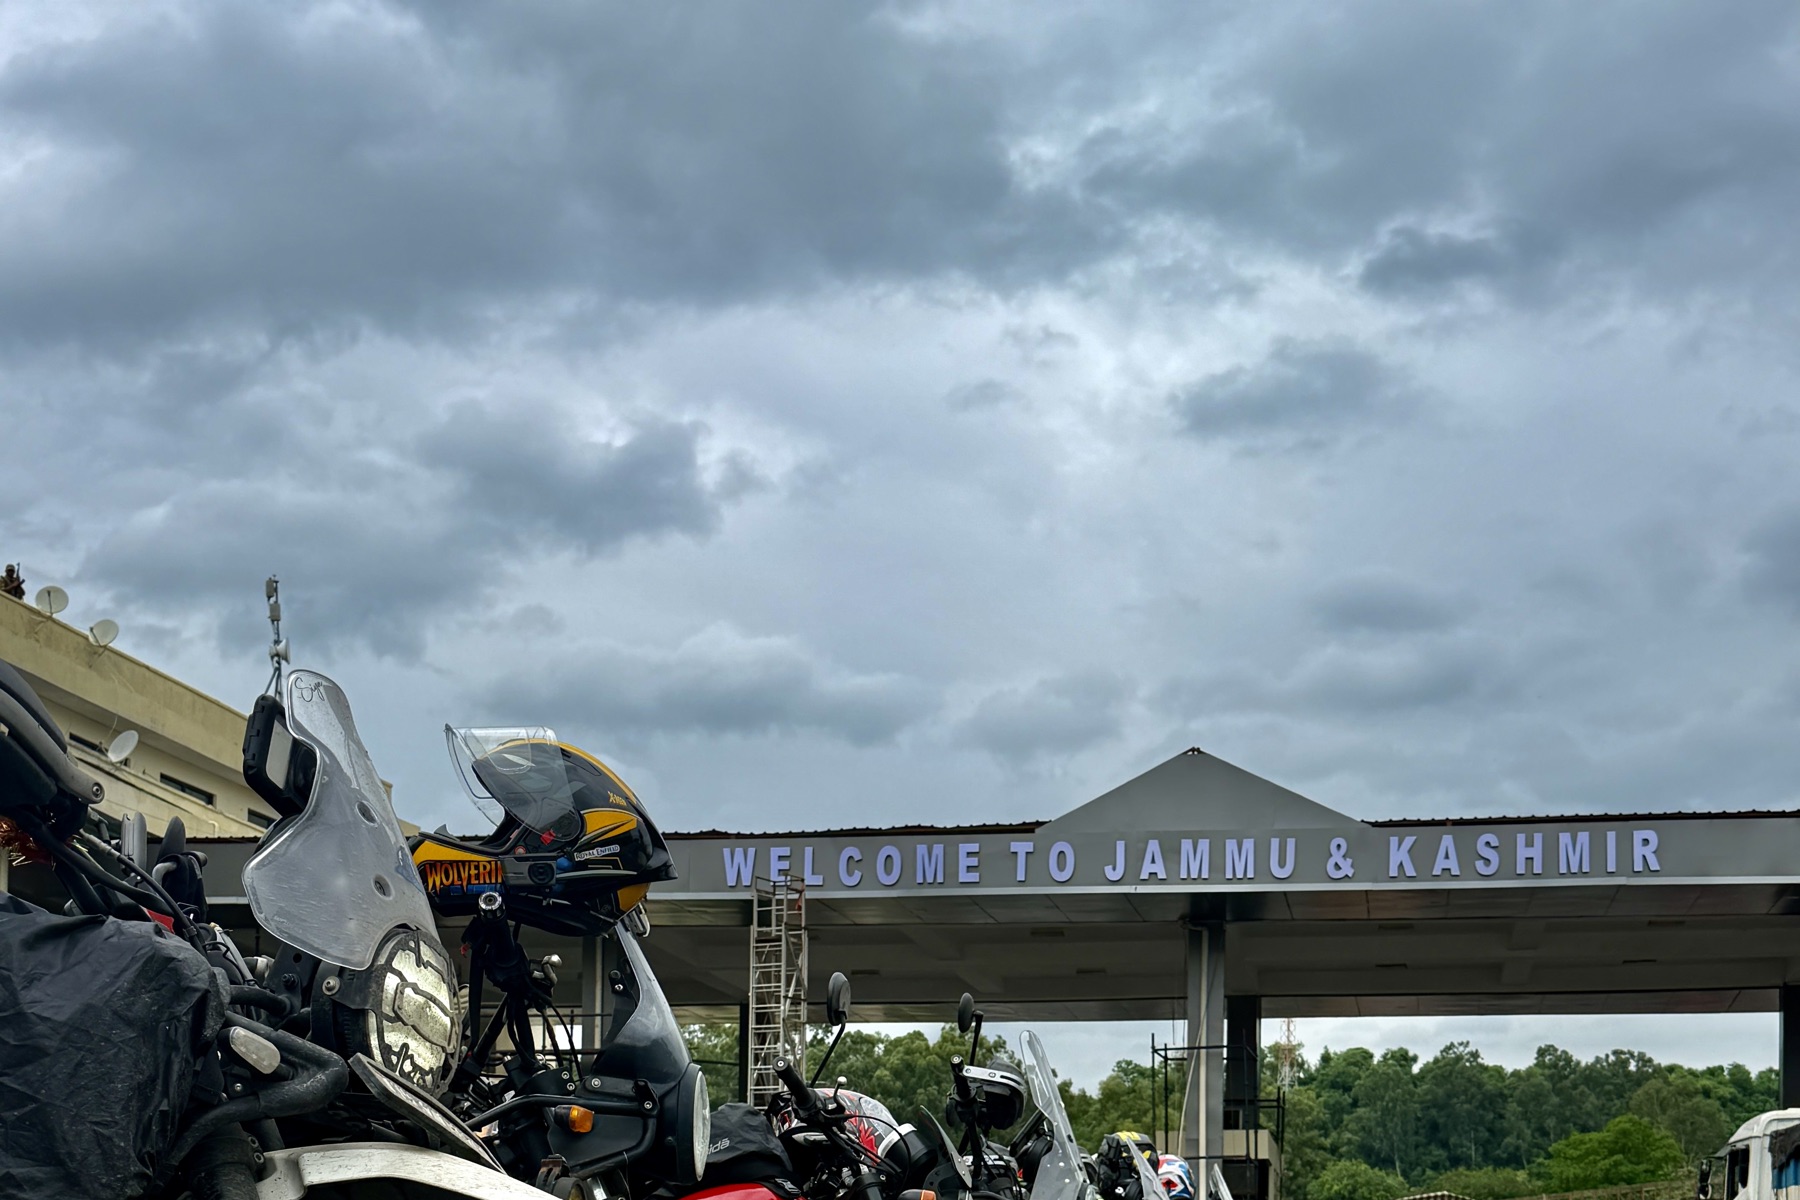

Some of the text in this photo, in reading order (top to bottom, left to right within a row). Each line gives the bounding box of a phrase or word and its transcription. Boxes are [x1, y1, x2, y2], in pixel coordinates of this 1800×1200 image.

[425, 860, 503, 895] WOLVERI
[722, 829, 1661, 887] WELCOME TO JAMMU & KASHMIR
